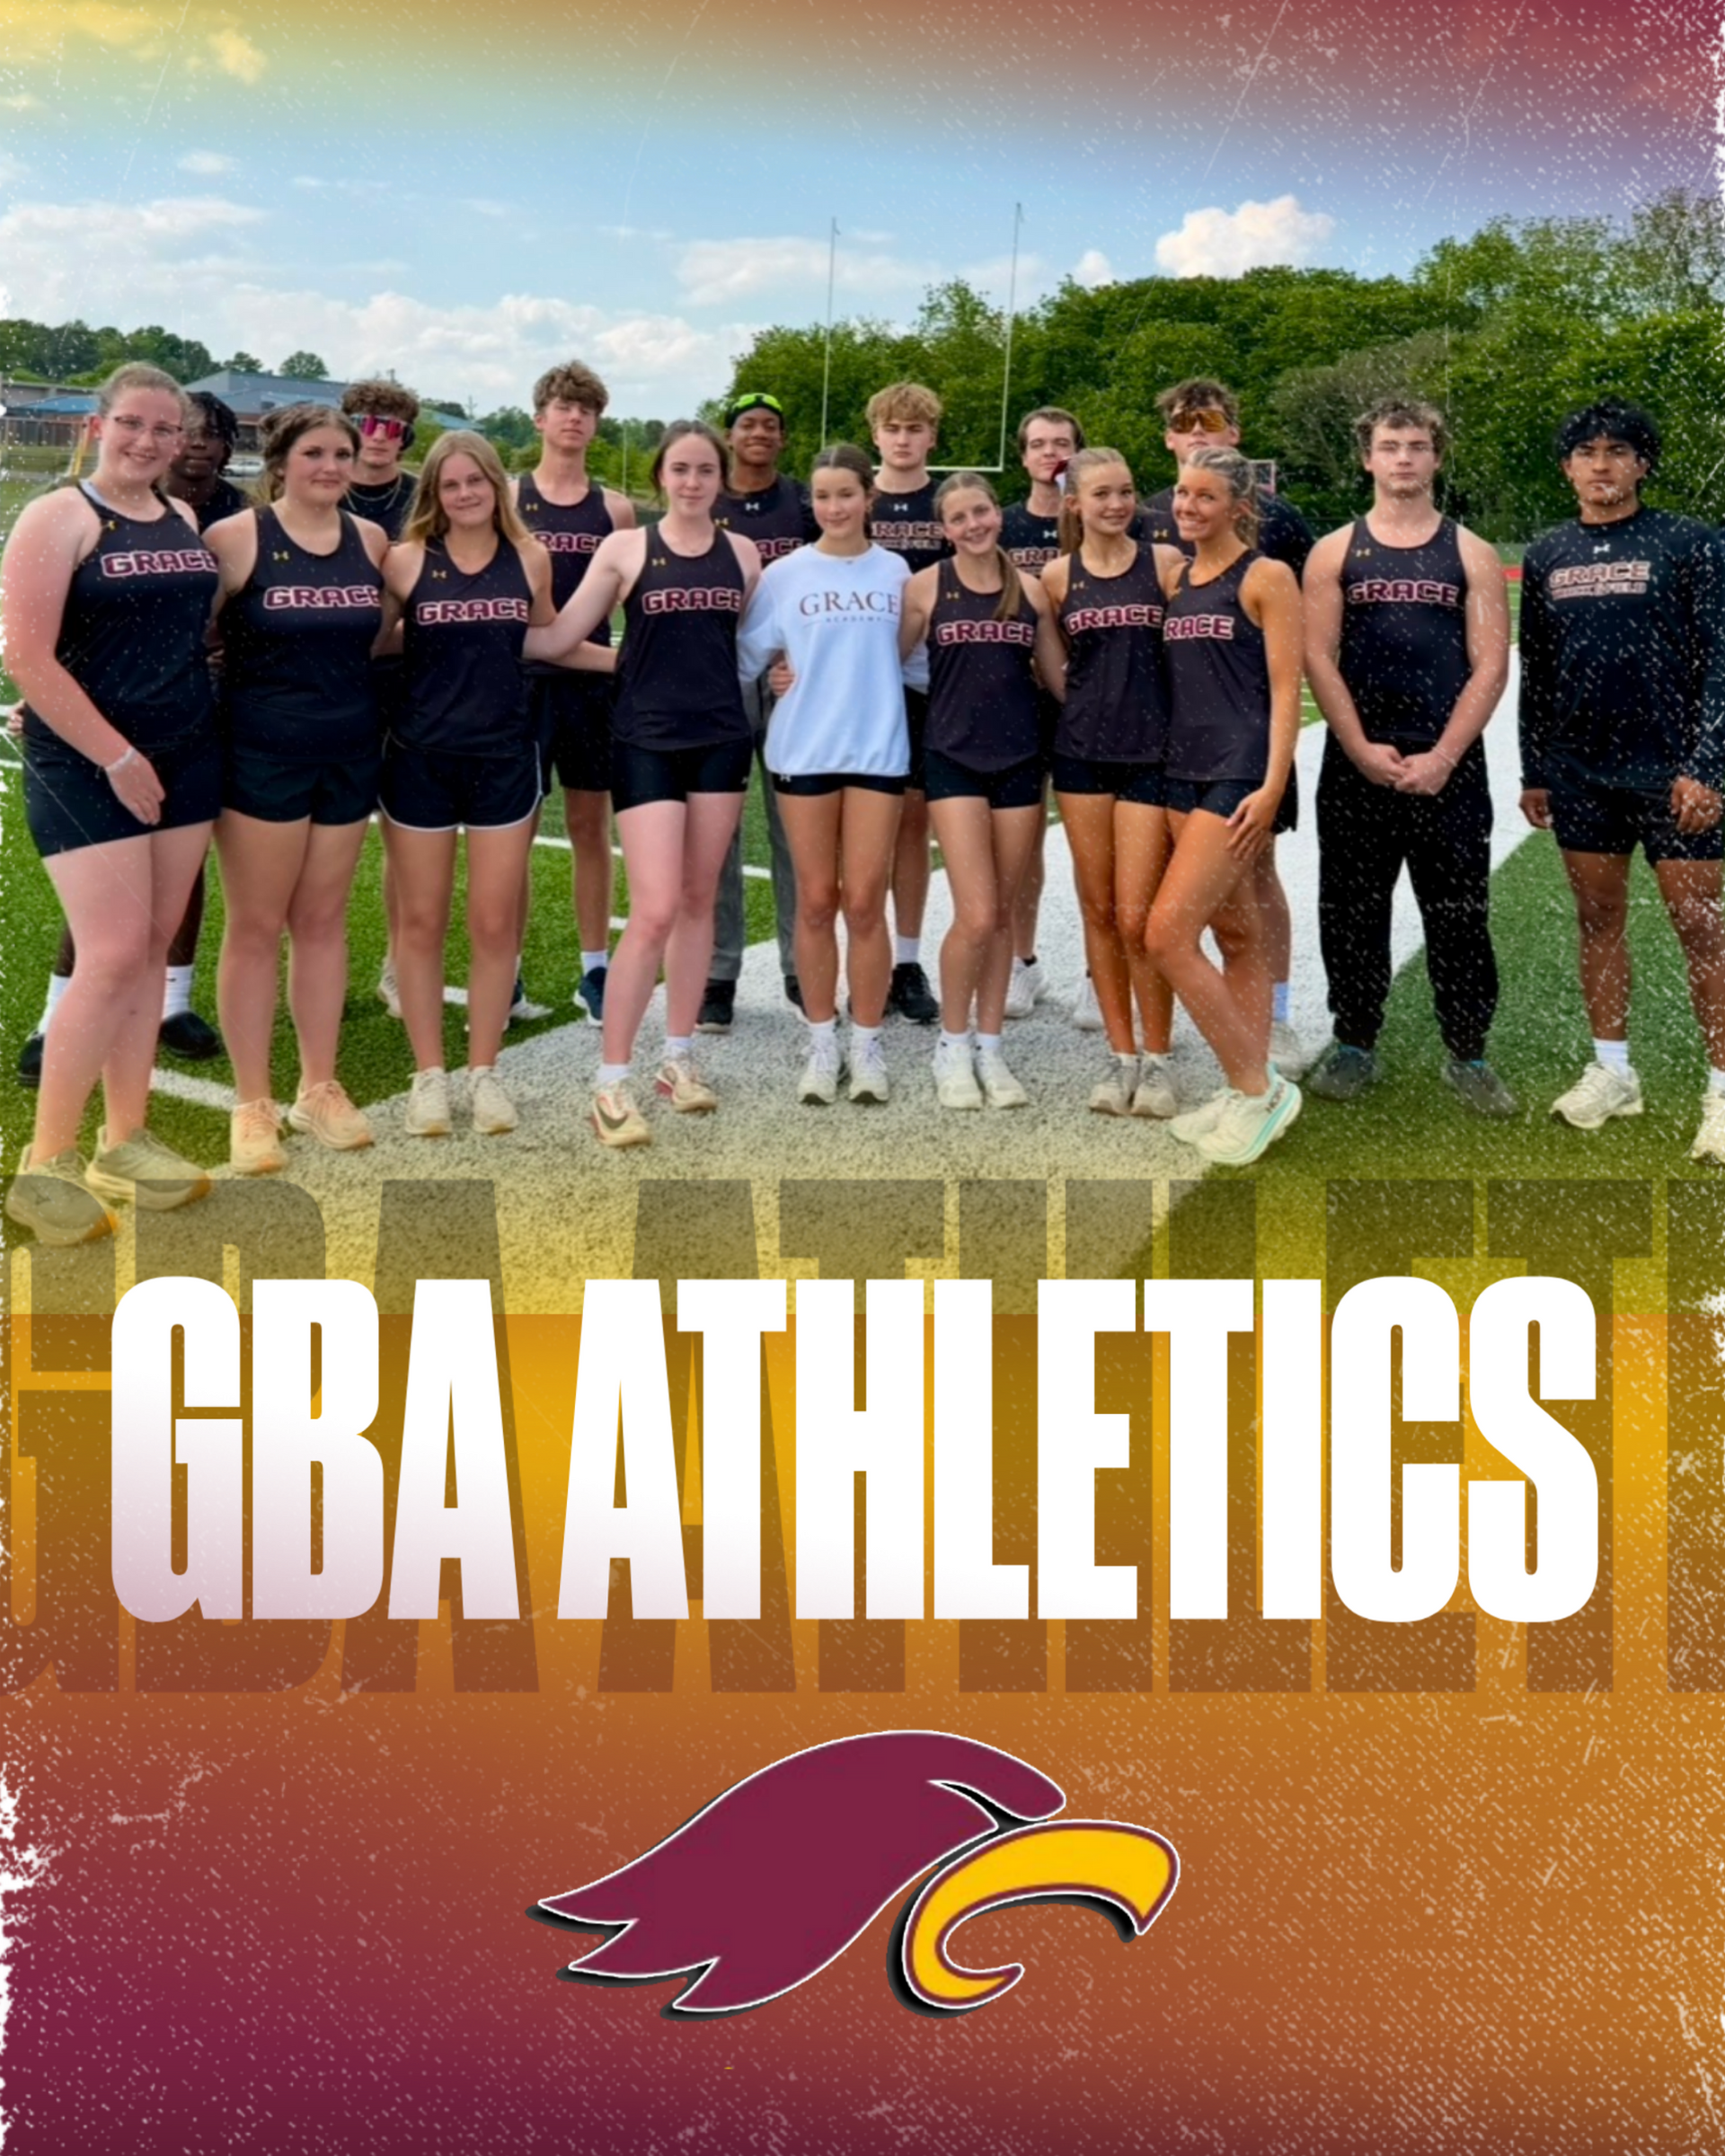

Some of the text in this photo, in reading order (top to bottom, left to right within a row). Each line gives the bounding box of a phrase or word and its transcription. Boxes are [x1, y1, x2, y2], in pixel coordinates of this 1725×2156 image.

[533, 531, 603, 553] RAC
[871, 521, 944, 538] RACE
[1008, 547, 1061, 564] GRA
[1549, 561, 1651, 589] GRACE
[799, 591, 898, 616] GRACE
[1348, 579, 1459, 606] GRACE
[1065, 604, 1163, 635] GRACE
[1163, 614, 1234, 641] RACE
[936, 620, 1035, 647] GRACE
